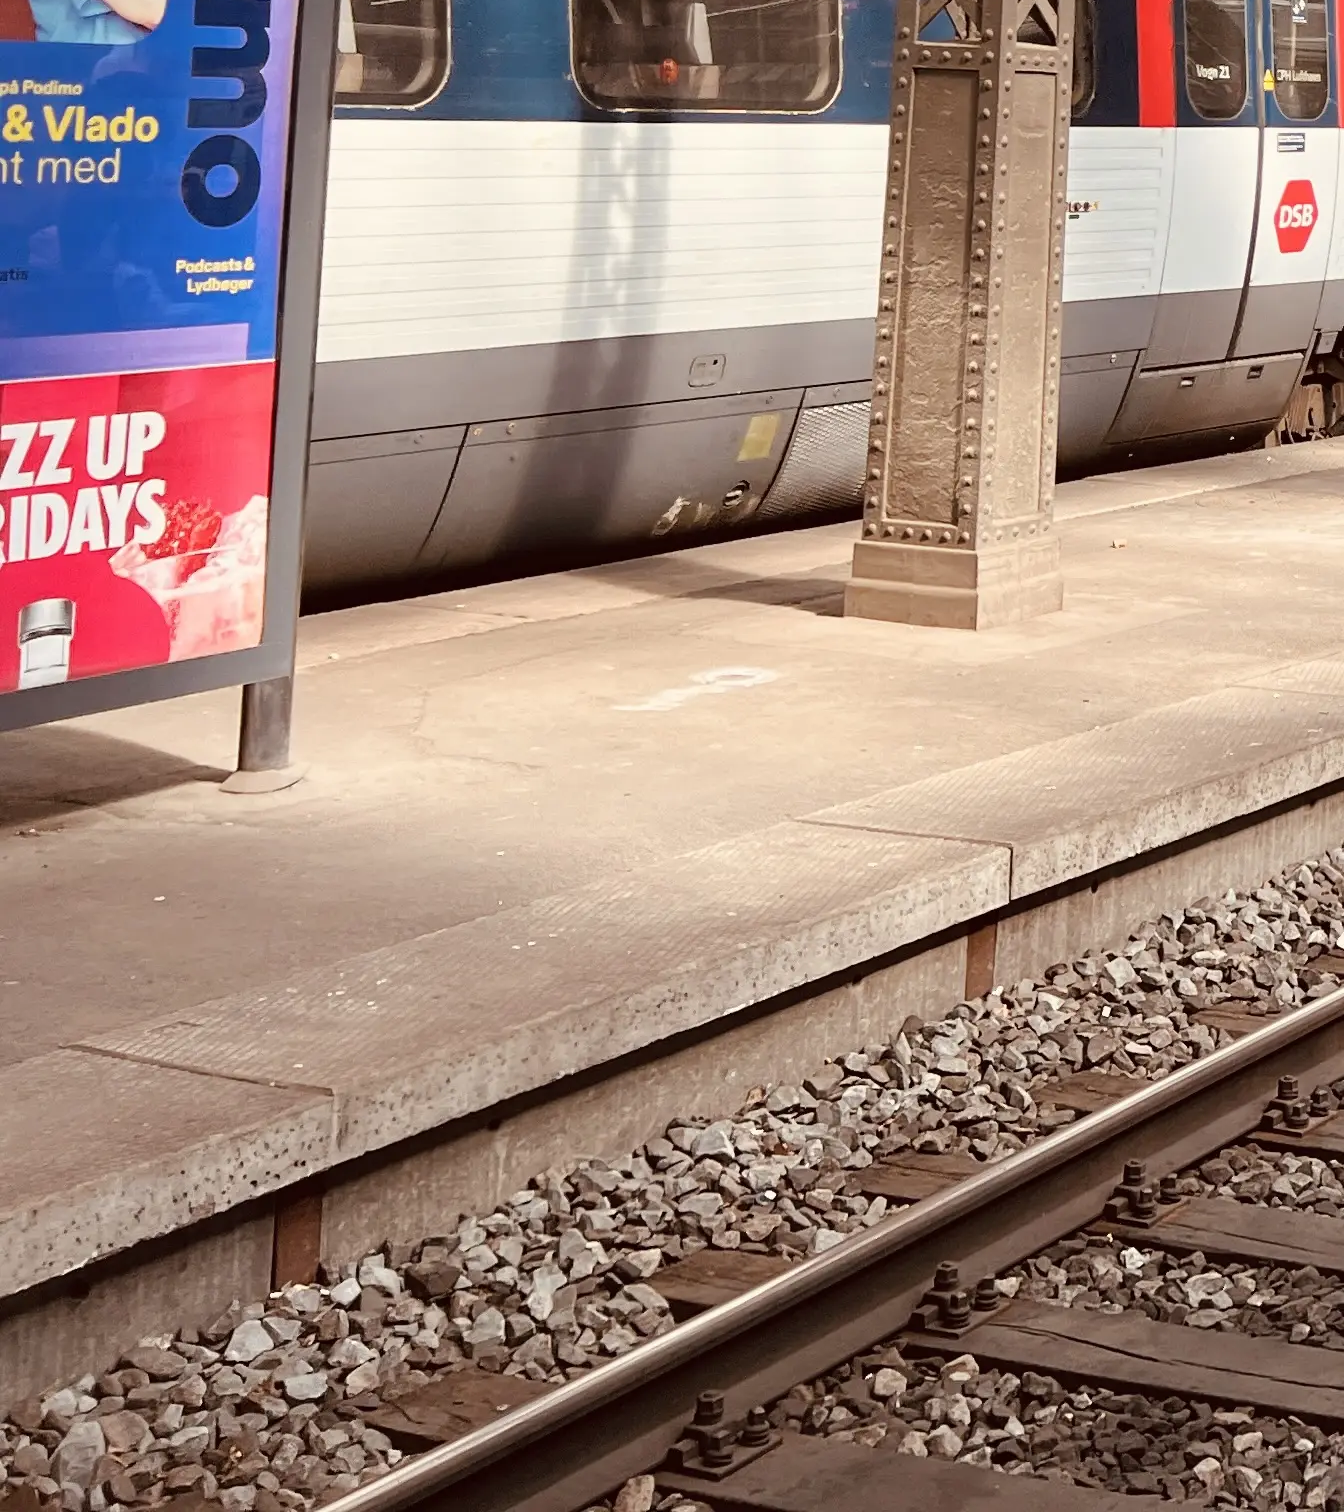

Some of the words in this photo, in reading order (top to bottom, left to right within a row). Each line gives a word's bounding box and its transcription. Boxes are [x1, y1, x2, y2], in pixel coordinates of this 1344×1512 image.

[22, 79, 83, 95] Podimo
[1196, 65, 1219, 80] Vogn
[1219, 65, 1230, 79] 21
[2, 104, 35, 143] &
[42, 105, 160, 143] Vlado
[37, 147, 121, 184] med
[1279, 203, 1314, 229] DSB
[175, 258, 241, 274] Podcasts
[242, 256, 256, 272] &
[0, 418, 77, 491] ZZ
[86, 411, 167, 481] UP
[0, 478, 167, 564] IDAYS
